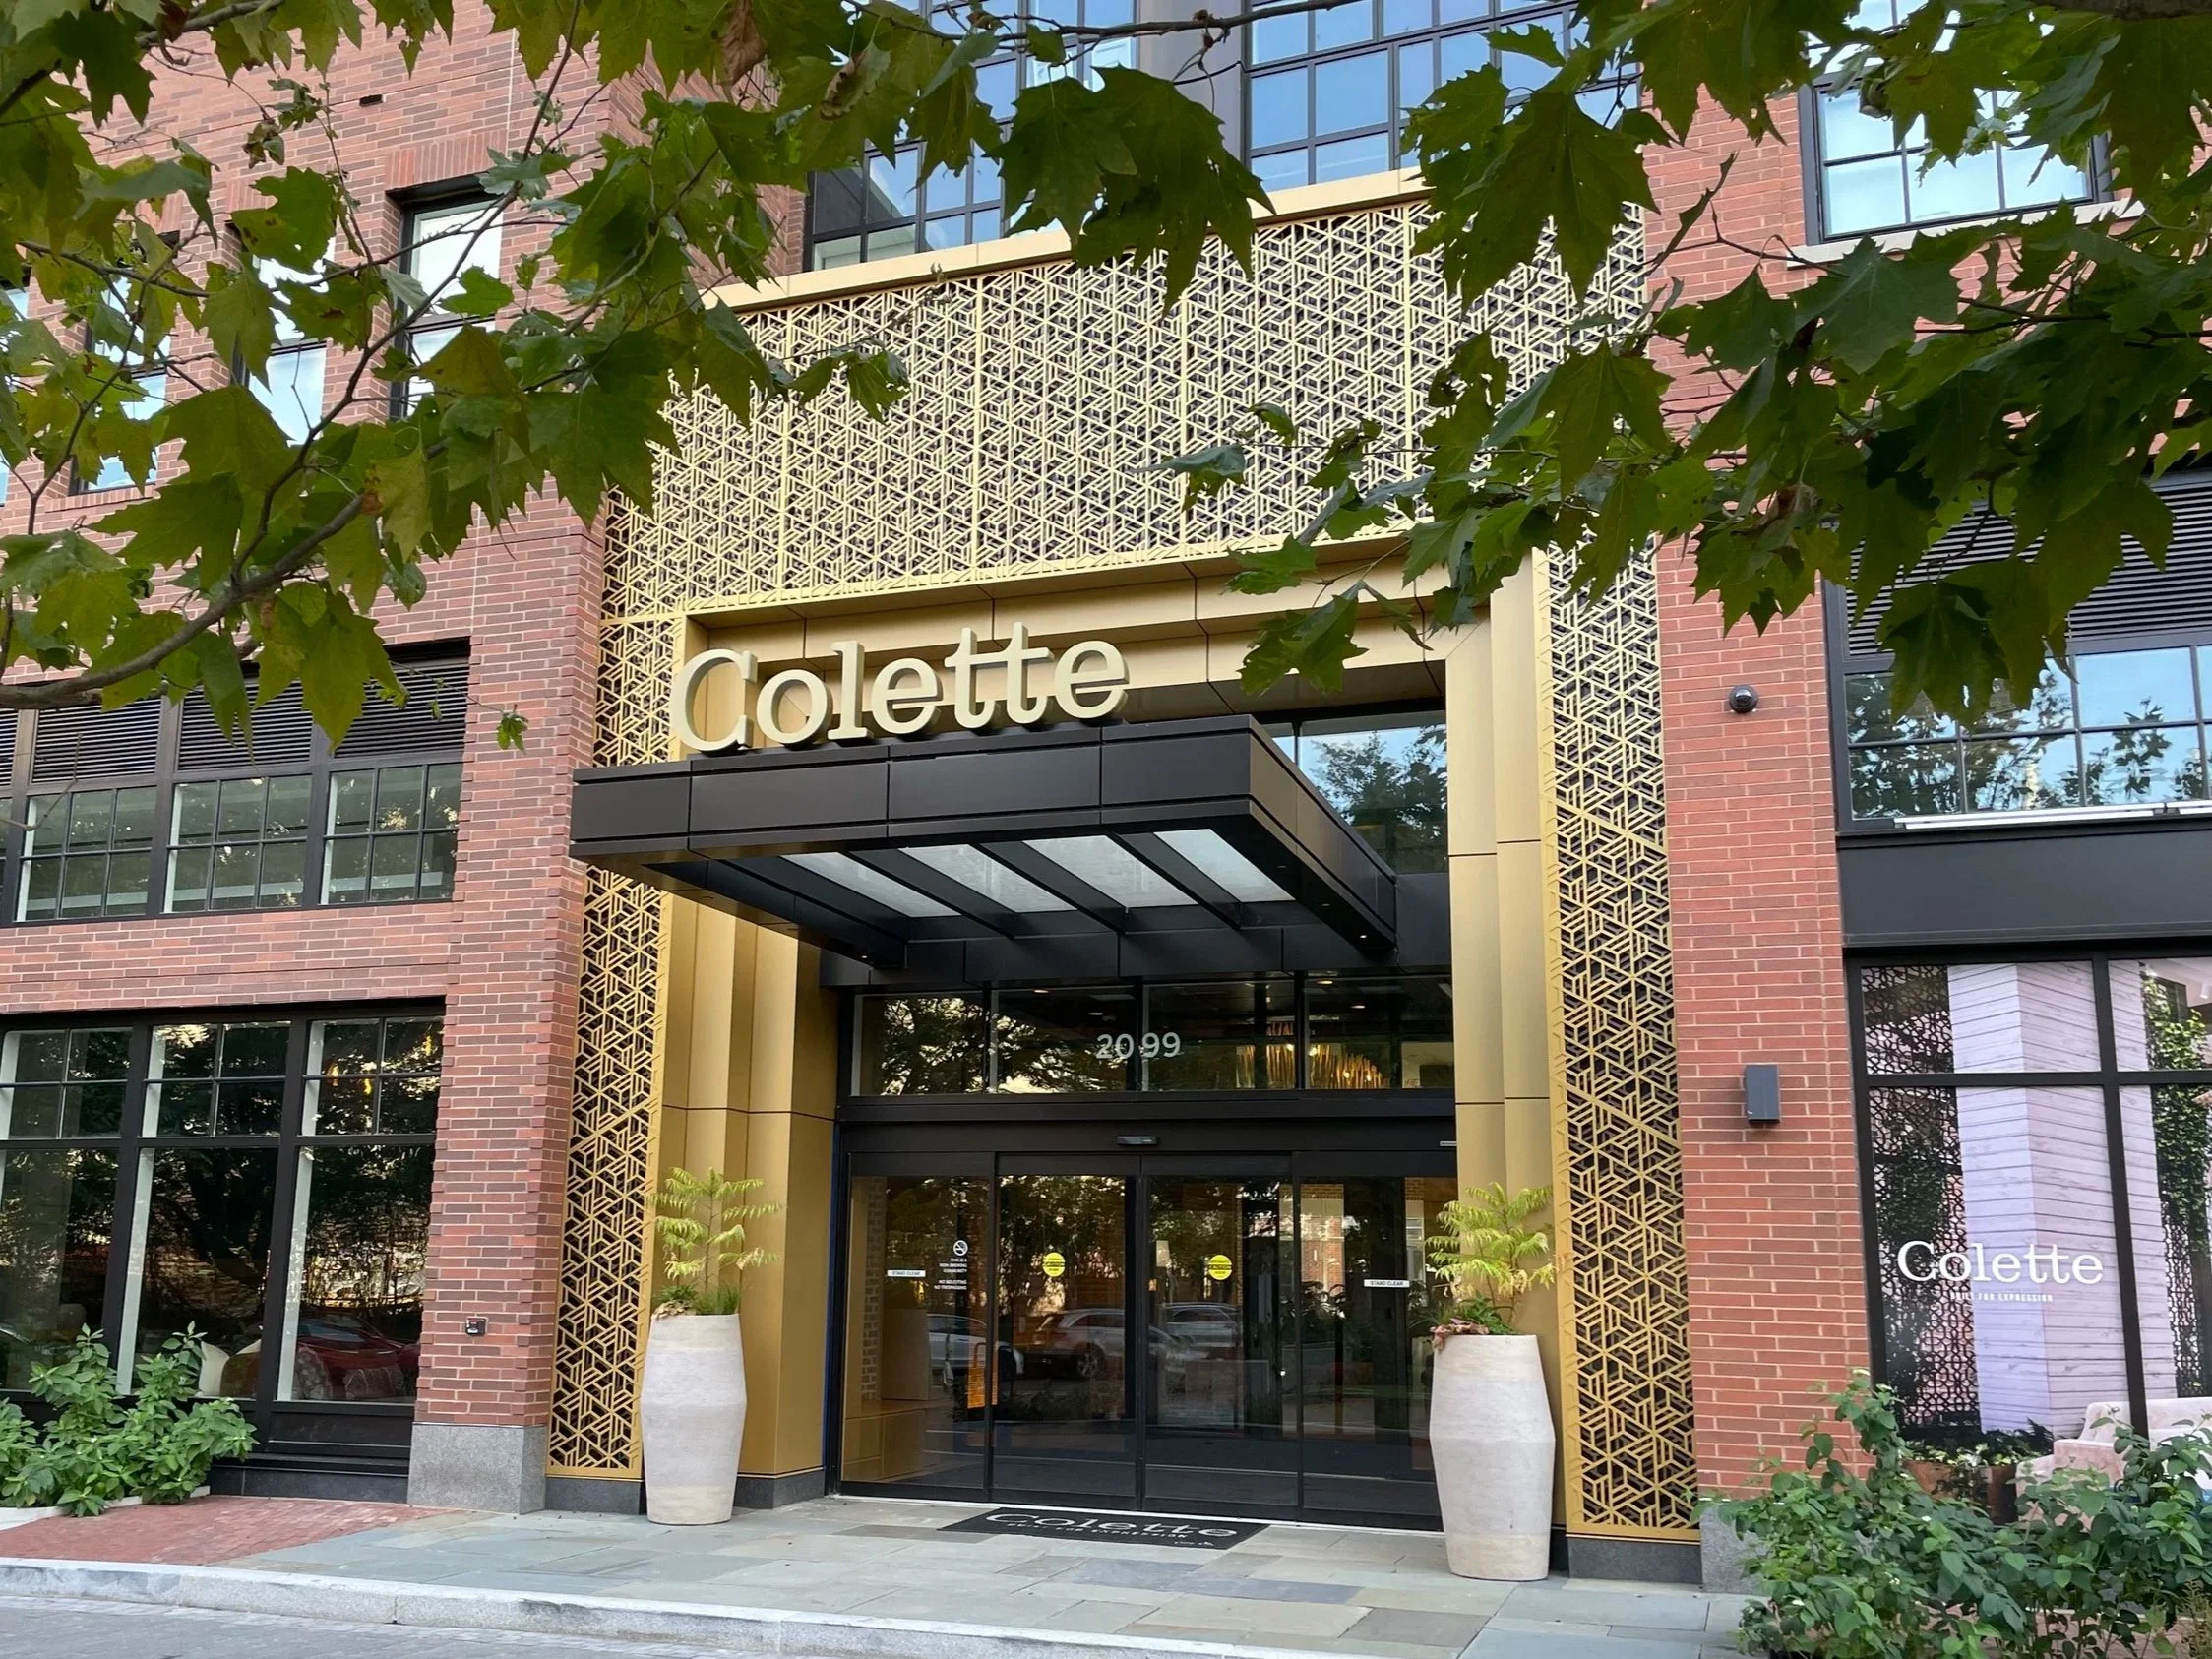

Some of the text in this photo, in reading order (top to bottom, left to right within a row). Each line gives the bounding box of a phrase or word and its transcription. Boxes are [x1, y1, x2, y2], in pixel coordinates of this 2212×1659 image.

[670, 621, 1130, 753] Colette
[1095, 1031, 1182, 1060] 2099
[1897, 1240, 2104, 1285] Colette
[985, 1512, 1238, 1538] Colette
